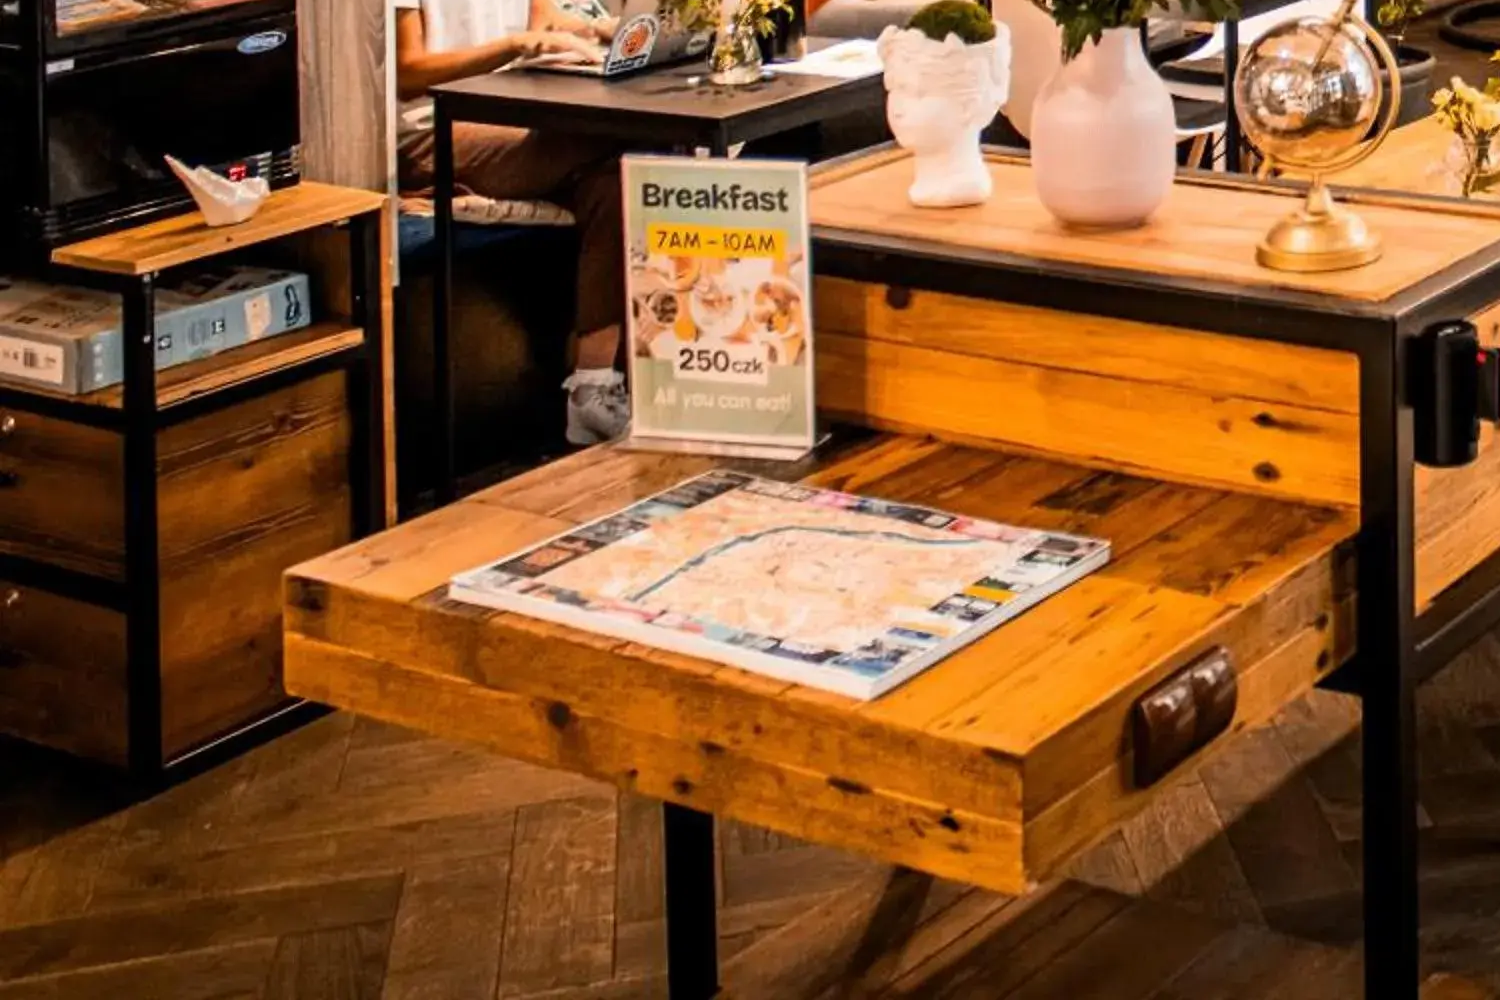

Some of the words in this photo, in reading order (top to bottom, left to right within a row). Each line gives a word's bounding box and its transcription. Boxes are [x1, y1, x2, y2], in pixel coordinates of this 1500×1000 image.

[641, 183, 789, 213] Breakfast
[656, 230, 701, 249] 7AM
[723, 233, 775, 252] 10AM
[653, 386, 677, 407] All
[681, 390, 716, 410] you
[717, 394, 753, 409] can
[755, 391, 793, 414] eat!
